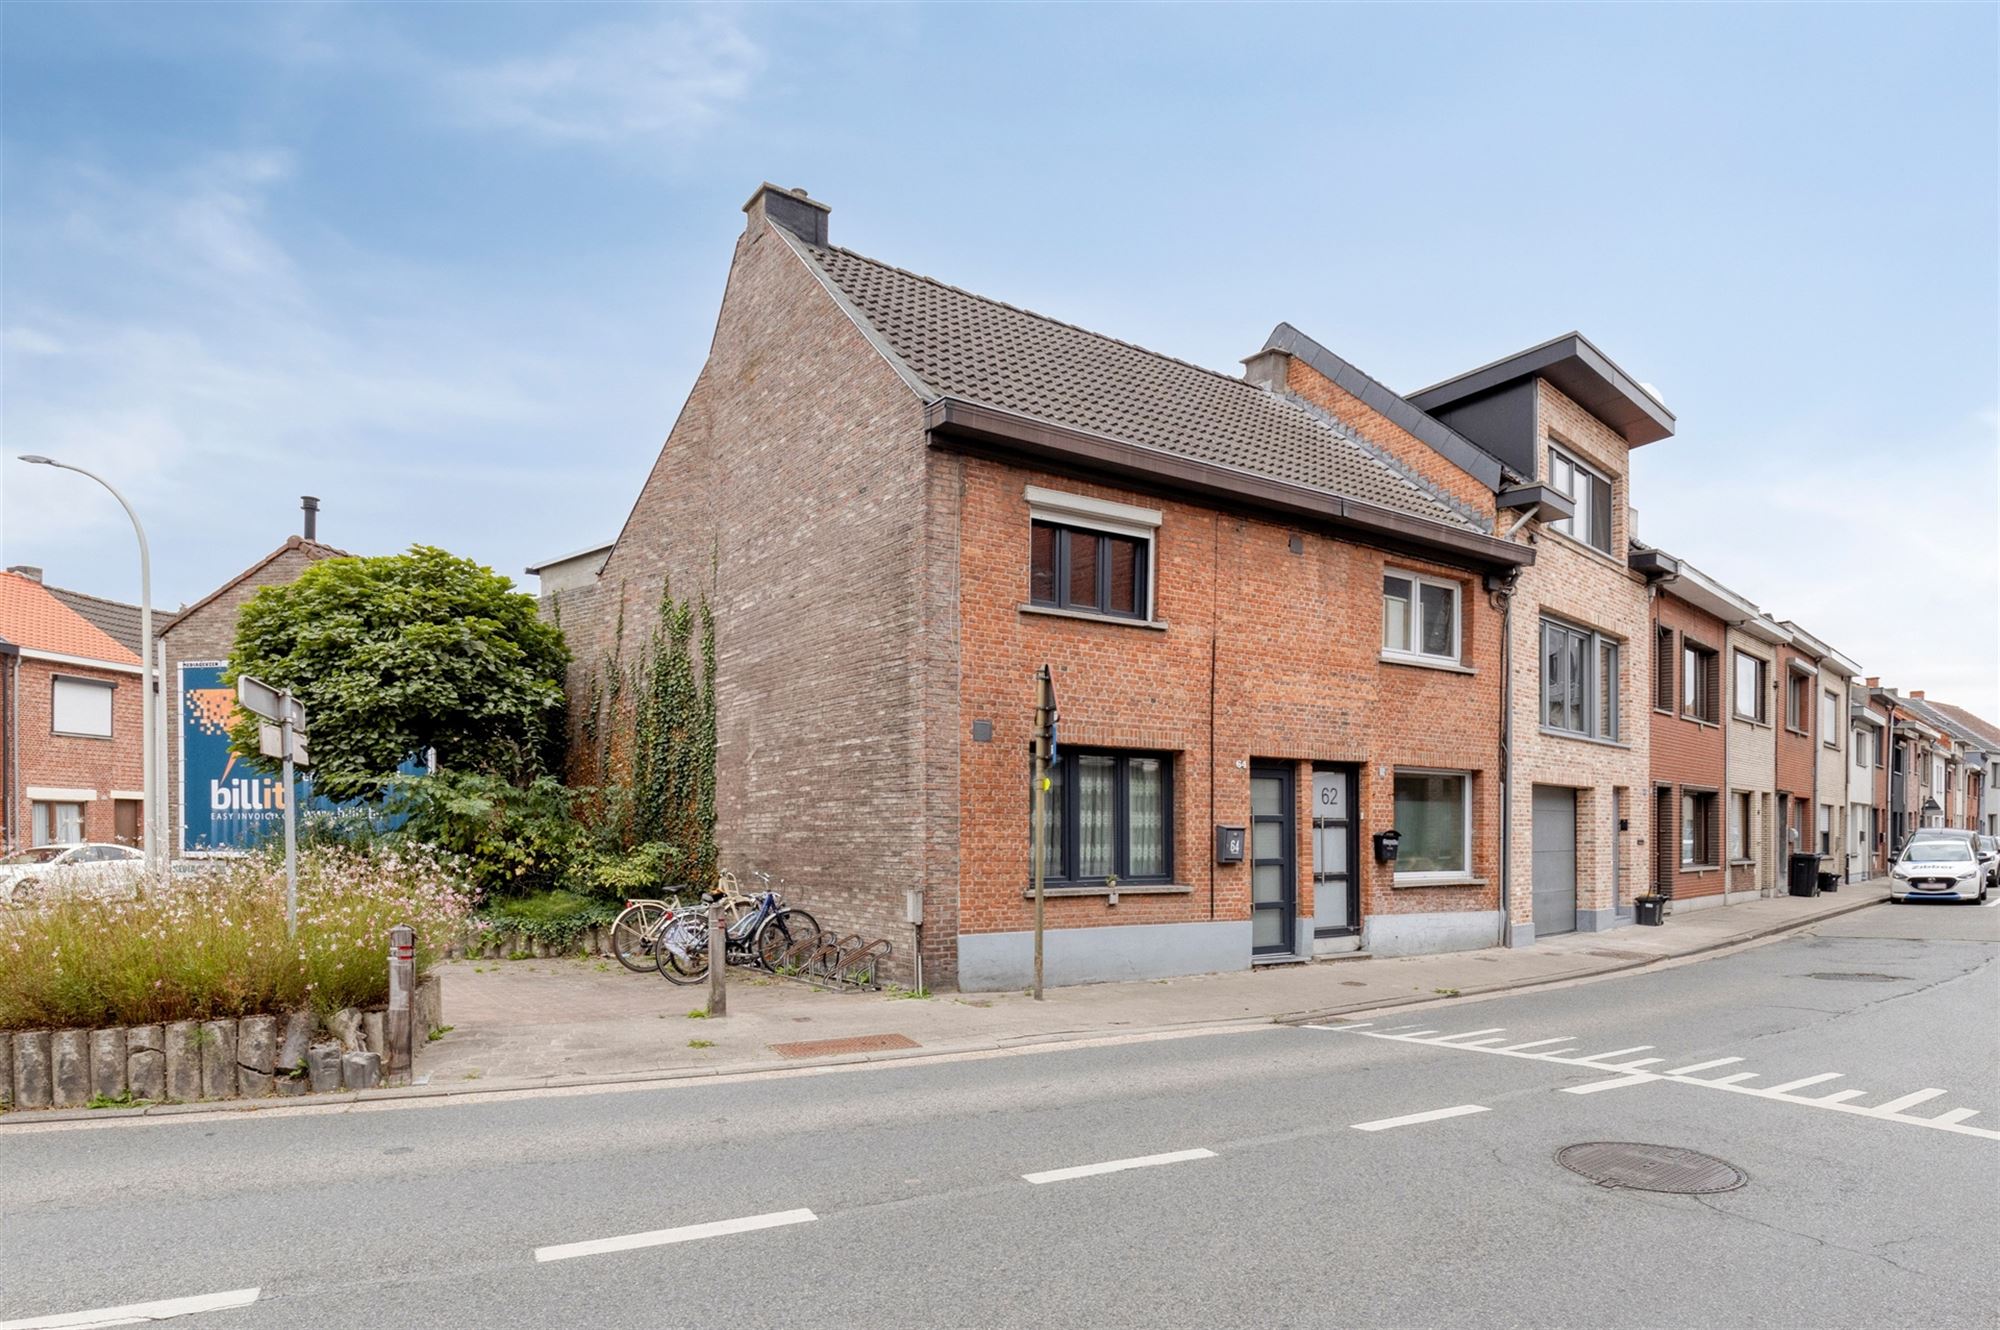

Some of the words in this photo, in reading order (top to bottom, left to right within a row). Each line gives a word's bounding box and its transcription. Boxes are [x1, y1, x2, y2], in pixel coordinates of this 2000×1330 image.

[1236, 760, 1246, 769] 64
[210, 778, 286, 810] billit
[1321, 787, 1338, 805] 62
[211, 812, 234, 820] EASY
[1229, 839, 1240, 855] 64
